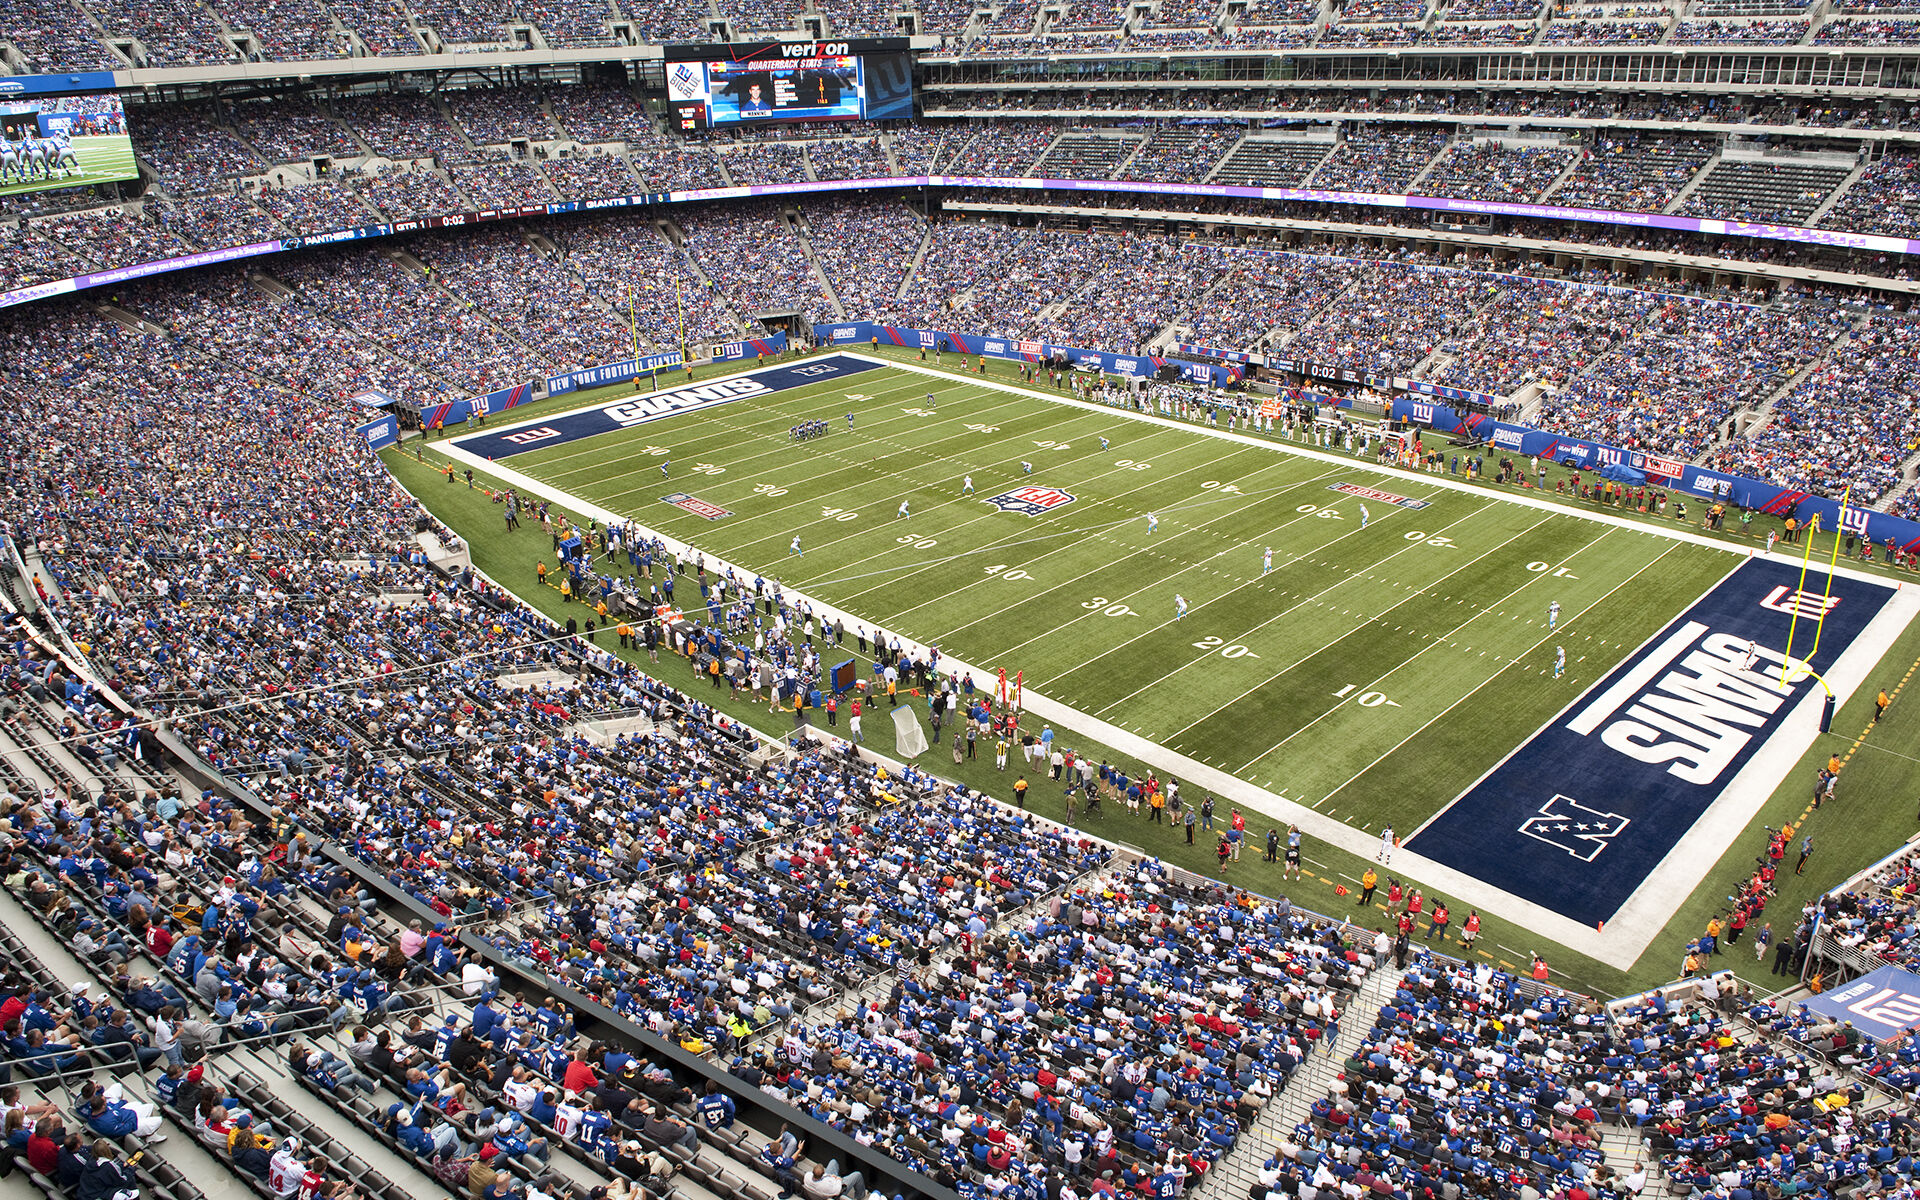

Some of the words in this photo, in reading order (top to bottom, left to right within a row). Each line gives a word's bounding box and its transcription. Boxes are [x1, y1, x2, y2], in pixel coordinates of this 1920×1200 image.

[781, 40, 849, 58] verizon
[748, 60, 798, 70] QUARTERBACK
[799, 59, 823, 68] STATS
[670, 76, 685, 92] BIG
[683, 76, 701, 98] BLUE
[585, 198, 627, 209] GIANTS
[441, 215, 465, 227] 0:02
[304, 230, 355, 245] PANTHERS
[360, 228, 366, 237] 3
[833, 327, 857, 337] GIANTS
[1115, 359, 1137, 371] GIANTS
[1312, 365, 1336, 379] 0:02
[550, 379, 570, 393] NEW
[572, 370, 597, 386] YORK
[600, 362, 644, 381] FOOTBALL
[647, 354, 681, 371] GIANTS
[603, 377, 767, 423] GIANTS
[368, 423, 389, 440] GIANTS
[1493, 428, 1523, 445] GIANTS
[753, 484, 789, 497] 30
[1014, 487, 1069, 508] NFL
[821, 506, 859, 522] 40
[1296, 504, 1340, 520] 30
[896, 533, 938, 550] 50
[1403, 531, 1453, 548] 20
[983, 563, 1028, 581] 40
[1525, 561, 1571, 578] 10
[1081, 596, 1131, 617] 30
[1192, 635, 1250, 659] 20
[1331, 683, 1389, 708] 10
[1601, 632, 1814, 786] GIANTS
[827, 807, 836, 815] 53
[883, 955, 891, 965] 21
[535, 1023, 549, 1039] 10
[786, 1046, 796, 1056] 10
[1131, 1075, 1140, 1083] 10
[1073, 1089, 1081, 1097] 10
[706, 1107, 725, 1125] 97
[1521, 1117, 1533, 1128] 91
[553, 1114, 567, 1135] 10
[581, 1123, 593, 1144] 11
[1296, 1132, 1307, 1141] 10
[1499, 1140, 1511, 1153] 10
[1520, 1150, 1530, 1159] 10
[1389, 1167, 1398, 1175] 10
[1828, 1169, 1836, 1180] 10
[1160, 1183, 1174, 1197] 91
